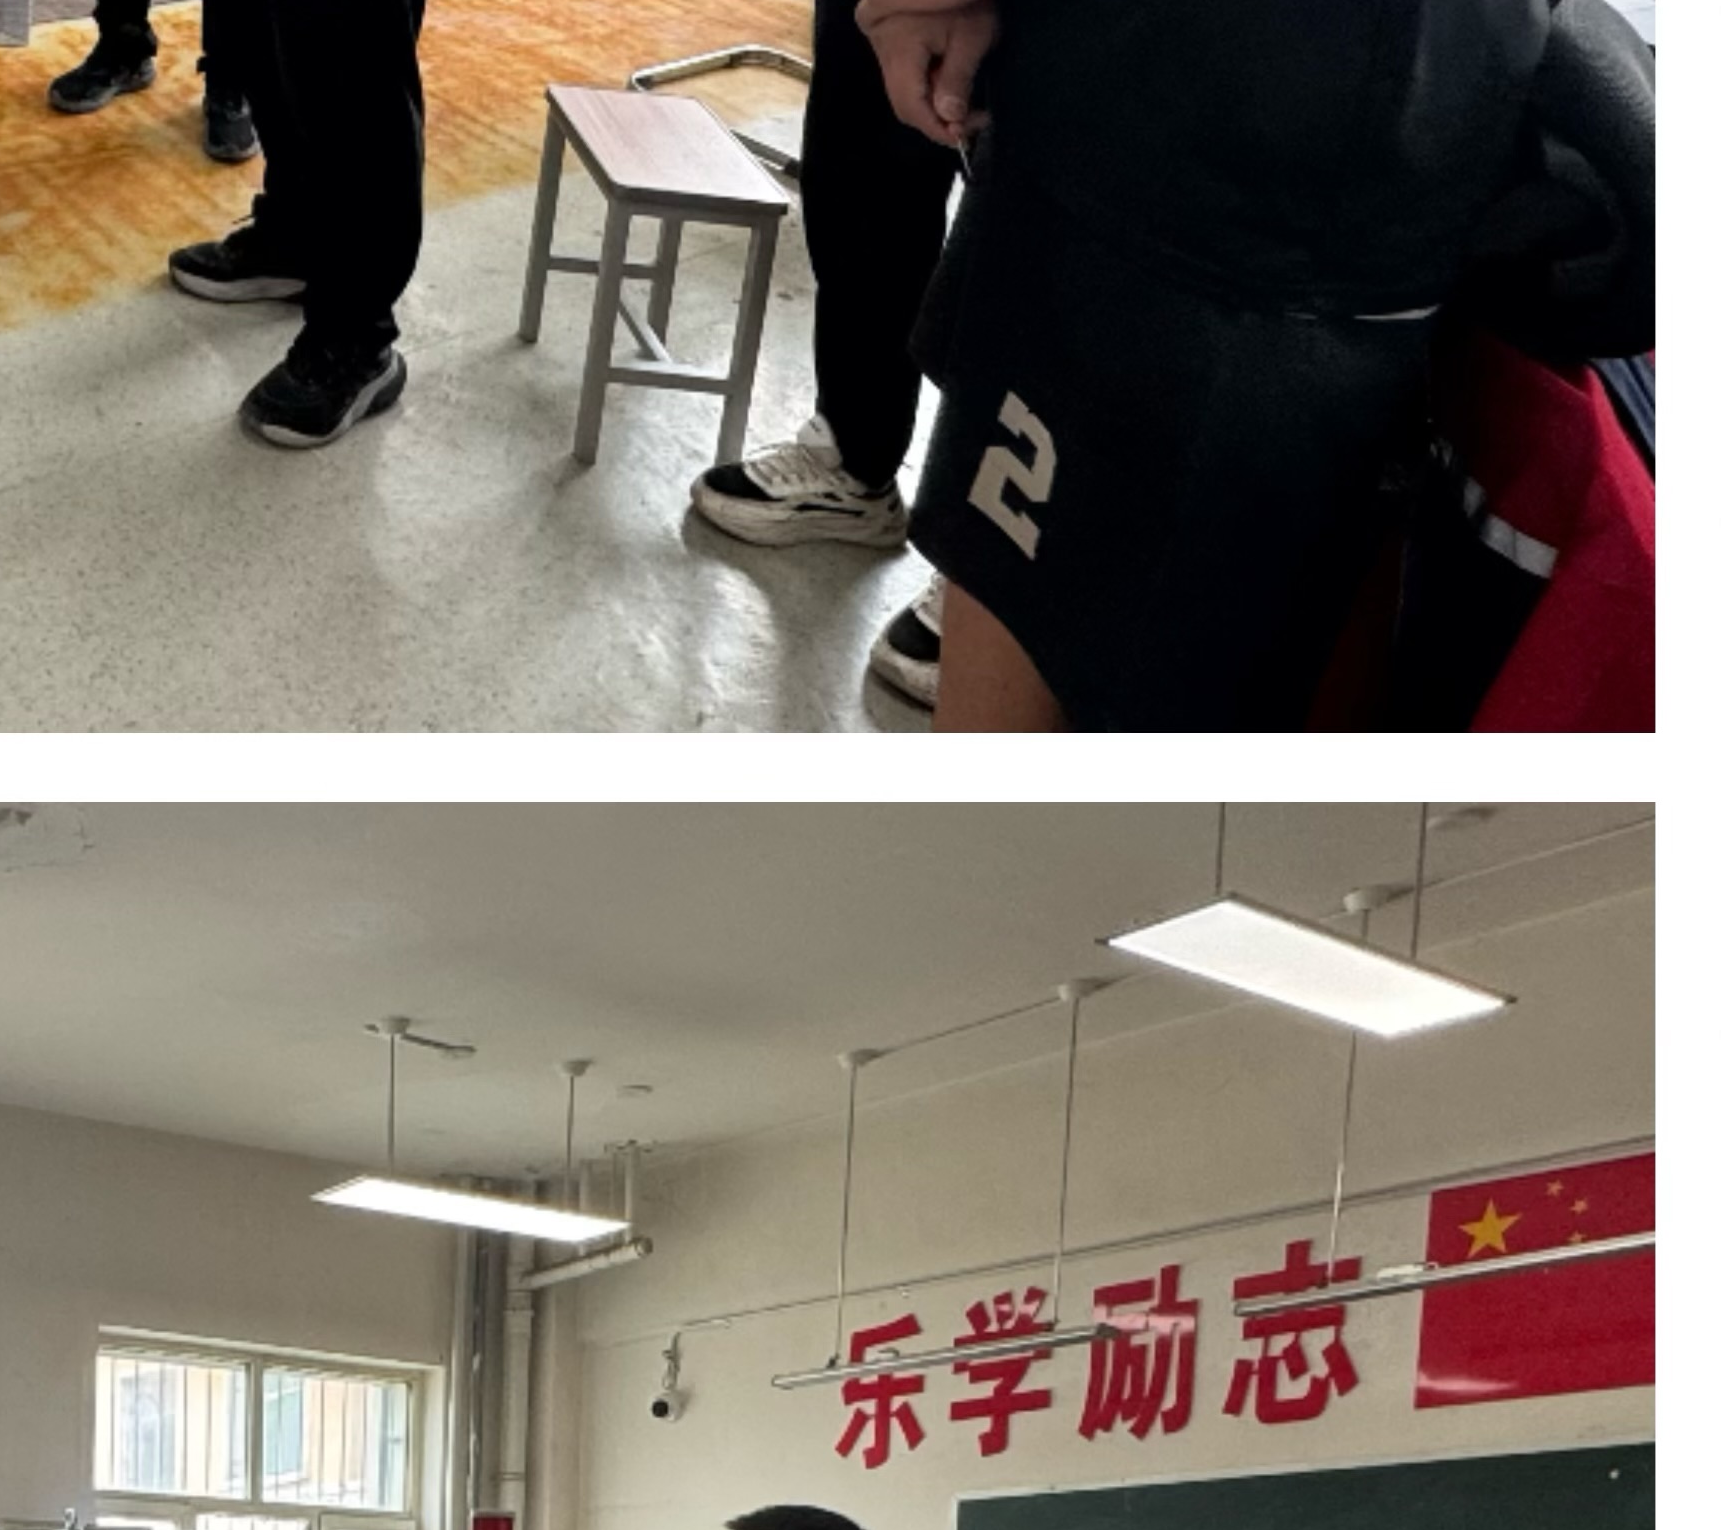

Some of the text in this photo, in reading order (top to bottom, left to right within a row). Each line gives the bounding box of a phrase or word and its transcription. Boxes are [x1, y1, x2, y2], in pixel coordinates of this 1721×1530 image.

[966, 389, 1058, 561] 2
[835, 1238, 1363, 1471] 乐学励志
